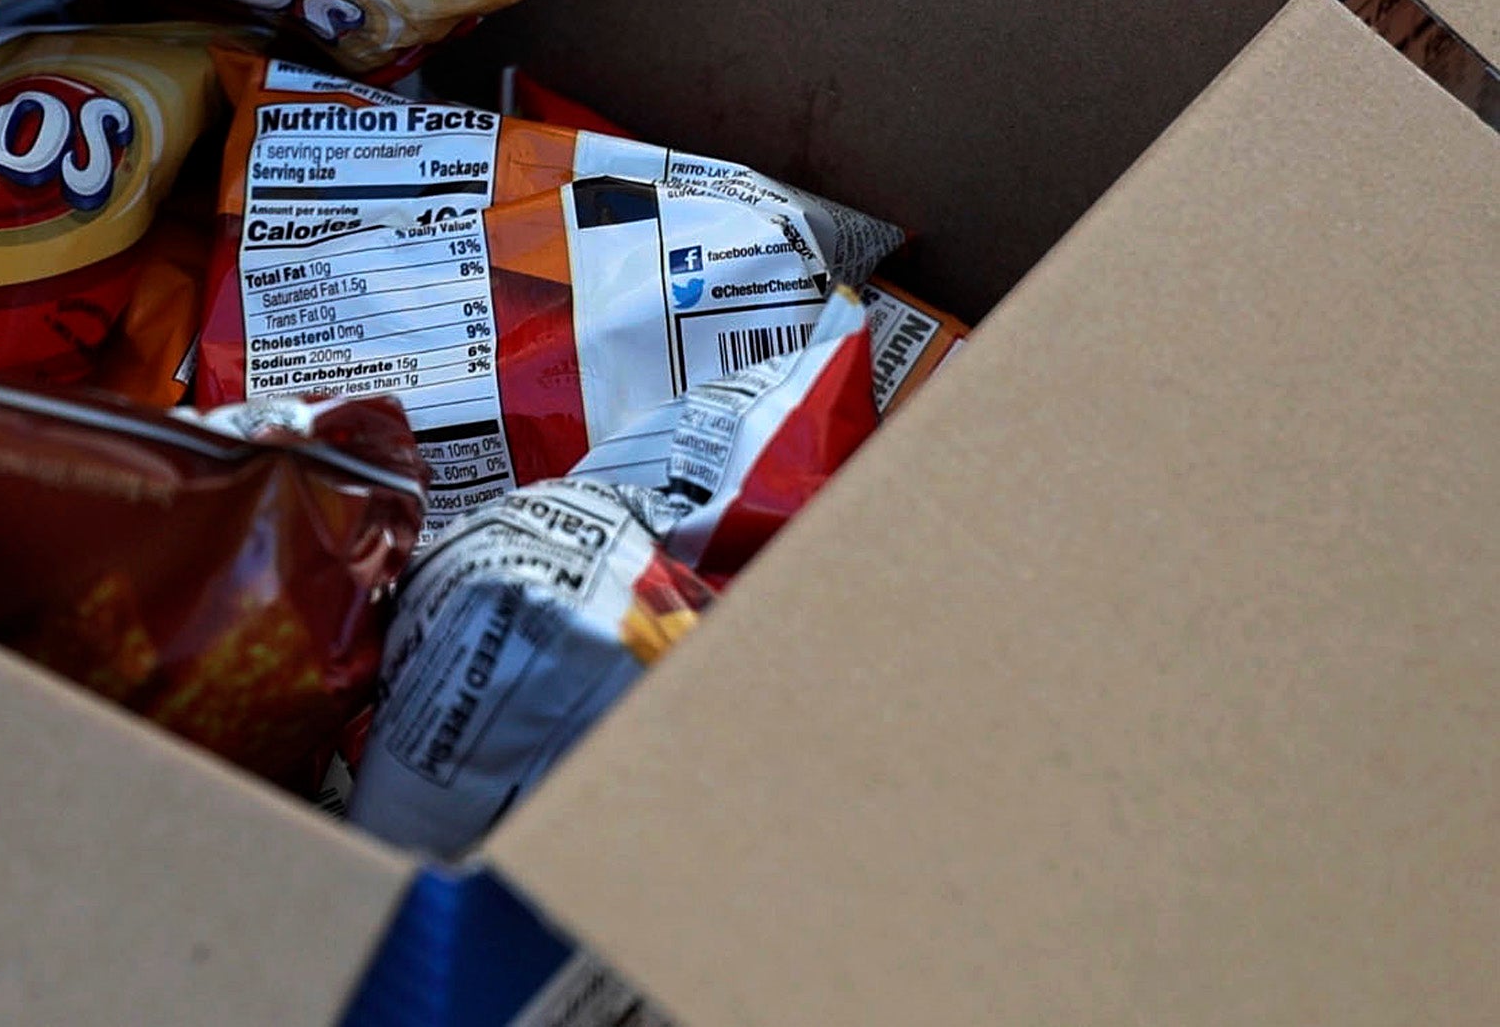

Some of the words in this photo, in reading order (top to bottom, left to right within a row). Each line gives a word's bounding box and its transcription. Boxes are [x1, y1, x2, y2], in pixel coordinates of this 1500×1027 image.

[260, 105, 398, 135] Nutrition
[406, 106, 495, 133] Facts
[267, 143, 322, 166] serving
[325, 145, 350, 165] per
[353, 142, 423, 161] container
[252, 162, 305, 183] Serving
[307, 164, 337, 181] size
[430, 159, 490, 181] Package
[250, 205, 294, 218] Amount
[294, 206, 315, 220] per
[316, 205, 360, 219] serving
[247, 218, 363, 243] Calories
[245, 271, 281, 289] Total
[283, 264, 307, 281] Fat
[309, 261, 332, 278] 10g
[449, 238, 482, 256] 13%
[262, 283, 319, 309] Saturated
[320, 280, 341, 298] Fat
[342, 277, 368, 294] 1.5g
[459, 260, 485, 277] 8%
[251, 327, 336, 353] Cholesterol
[337, 322, 365, 340] 0mg
[463, 300, 489, 318] 0%
[265, 314, 299, 331] Trans
[299, 309, 320, 324] Fat
[320, 305, 337, 321] 0g
[251, 353, 307, 371] Sodium
[309, 347, 353, 364] 200mg
[465, 322, 491, 339] 9%
[250, 373, 290, 390] Total
[292, 361, 394, 384] Carbohydrate
[396, 356, 419, 371] 15g
[467, 343, 492, 358] 6%
[346, 380, 372, 394] less
[373, 376, 401, 390] than
[403, 372, 420, 387] 1g
[467, 358, 492, 374] 3%
[447, 439, 480, 458] 10mg
[482, 435, 501, 451] 0%
[486, 457, 507, 473] 0%
